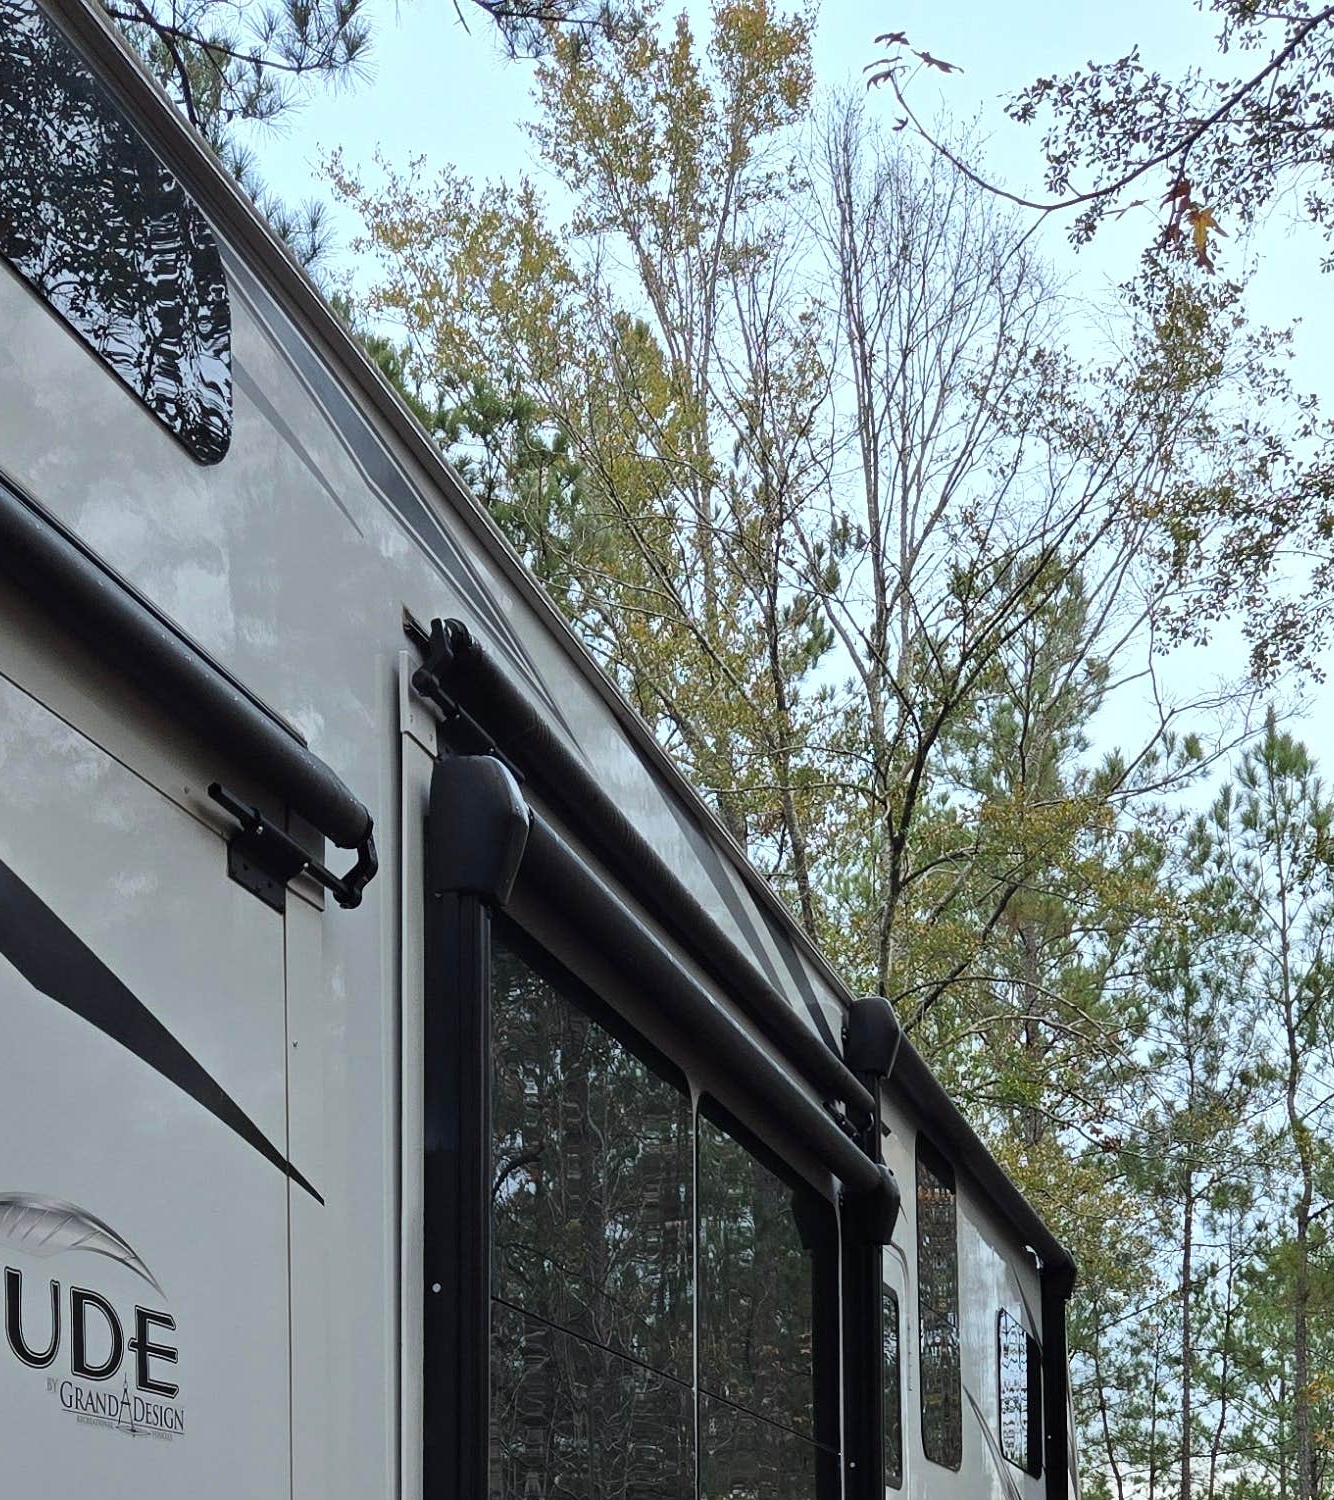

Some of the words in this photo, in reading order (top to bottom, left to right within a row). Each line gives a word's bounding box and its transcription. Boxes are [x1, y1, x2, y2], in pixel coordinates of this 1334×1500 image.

[47, 1377, 58, 1392] BY
[60, 1380, 119, 1418] GRAND
[133, 1396, 184, 1430] DESIGN
